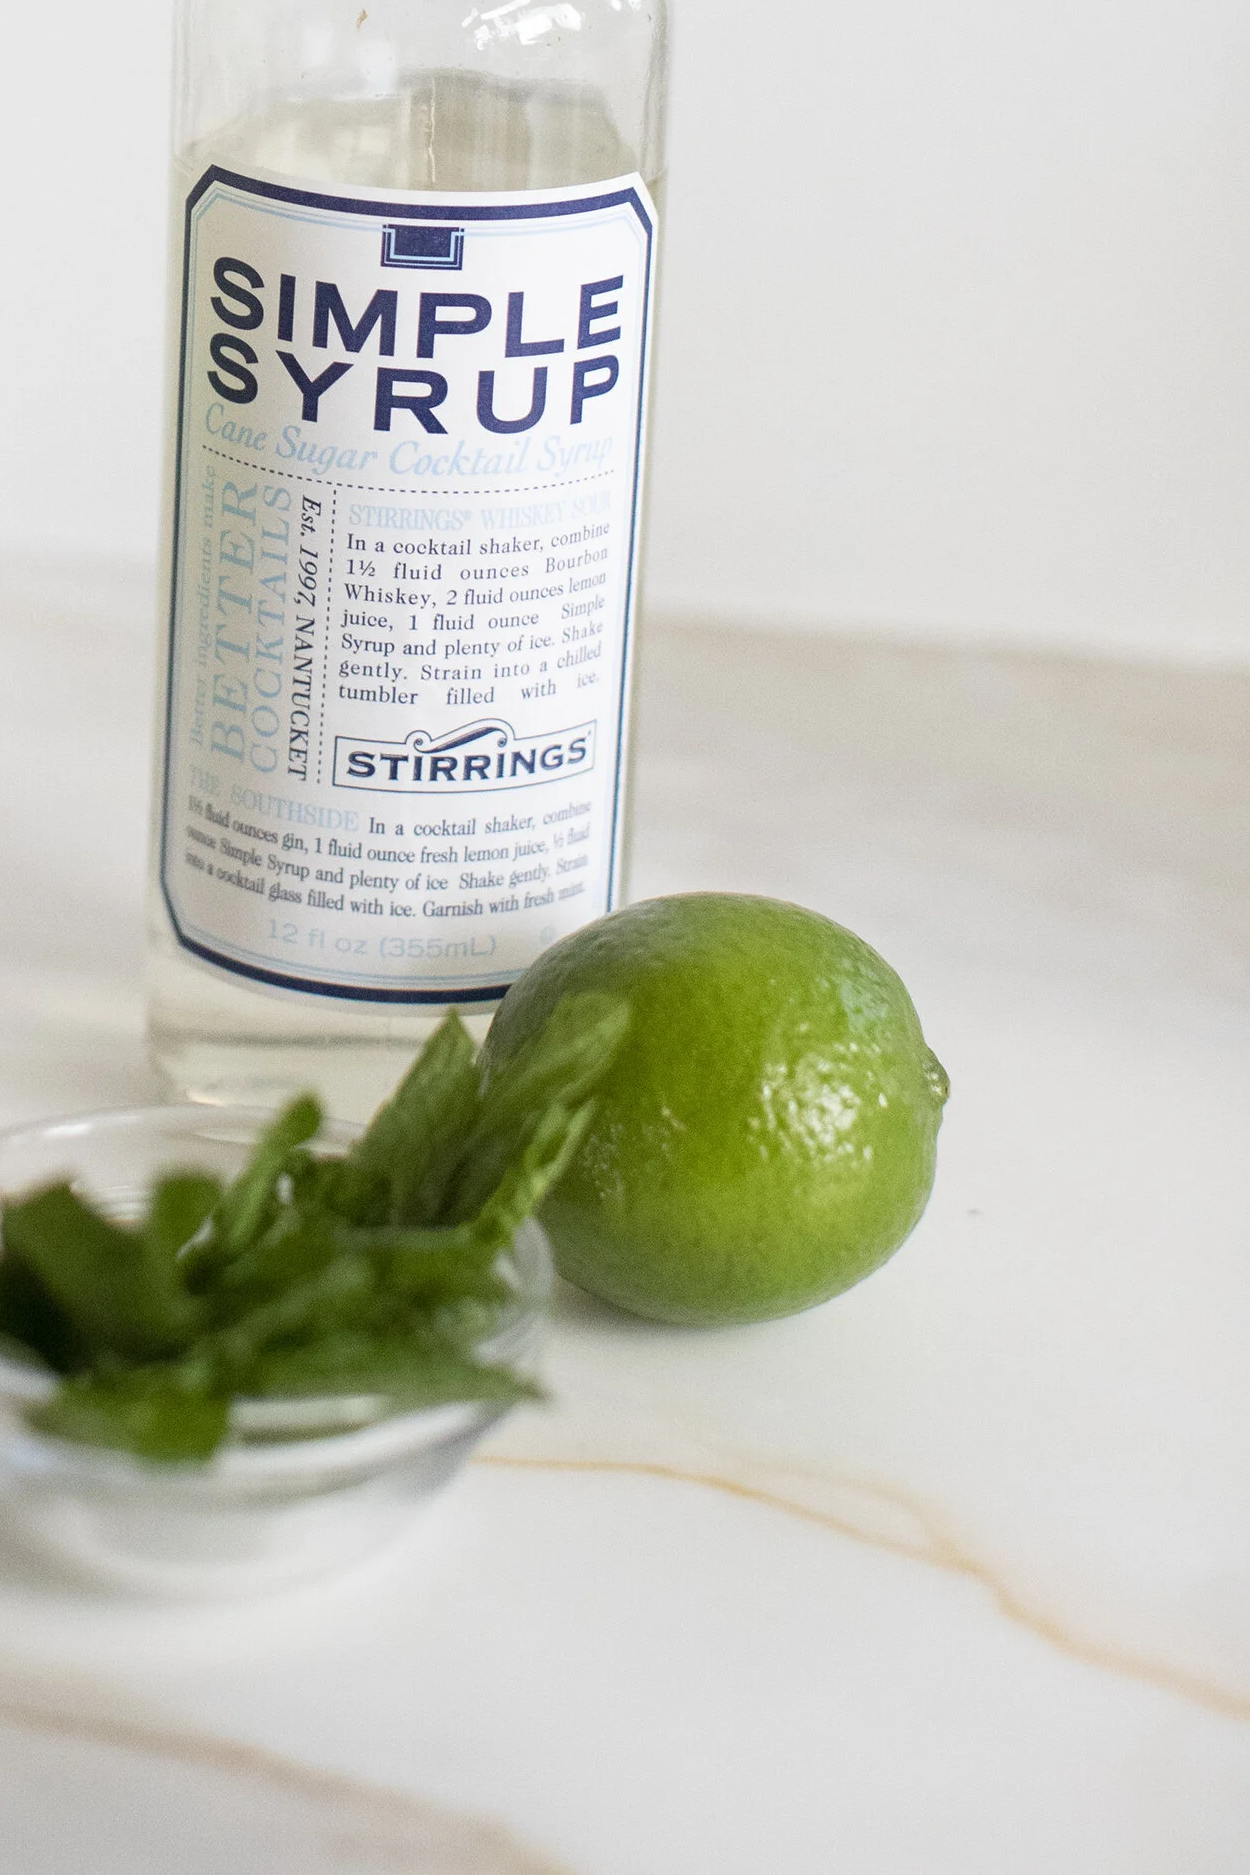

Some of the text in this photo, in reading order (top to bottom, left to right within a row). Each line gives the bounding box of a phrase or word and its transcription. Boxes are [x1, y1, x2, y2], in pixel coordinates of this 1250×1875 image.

[210, 256, 624, 359] SIMPLE
[207, 332, 620, 435] SYRUP
[203, 401, 614, 479] Cane Sugar Cocktail Syrup
[479, 500, 566, 531] WHISKEY
[347, 521, 609, 556] In a cocktail shaker, combine
[394, 562, 442, 581] fluid
[459, 563, 530, 581] ounces
[545, 547, 608, 574] Bourbon
[344, 571, 607, 609] Whiskey, 2 fluid ounces lemon
[211, 480, 258, 763] BETTER
[251, 485, 292, 774] COCKTAILS
[340, 594, 606, 633] juice, 1 fluid ounce Simple
[287, 495, 322, 782] Est. 1997, NANTUCKET
[341, 621, 604, 659] Syrup and plenty of ice. Shake
[339, 641, 602, 682] gently. Strain into a chilled
[339, 683, 418, 705] tumbler
[446, 686, 495, 705] filled
[521, 678, 557, 700] with
[346, 737, 588, 781] STIRRINGS
[230, 783, 592, 836] SOUTHSIDE In a cocktail shaker, combine
[233, 819, 278, 845] ounces
[281, 833, 309, 855] gin,
[315, 837, 322, 854] 1
[328, 837, 362, 860] fluid
[367, 847, 415, 864] ounce
[420, 845, 458, 863] fresh
[464, 845, 509, 863] lemon
[512, 839, 549, 862] juice,
[220, 836, 263, 867] Simple
[267, 853, 310, 879] Syrup
[315, 867, 344, 885] and
[349, 870, 399, 894] plenty
[405, 872, 422, 890] of
[459, 870, 504, 890] Shake
[216, 867, 265, 895] cocktail
[268, 881, 301, 903] glass
[307, 888, 344, 911] filled
[350, 896, 384, 915] with
[389, 900, 417, 917] ice.
[422, 898, 484, 918] Garnish
[489, 894, 519, 914] with
[523, 885, 555, 909] fresh
[268, 919, 498, 960] 12 fl oz (355mL)
